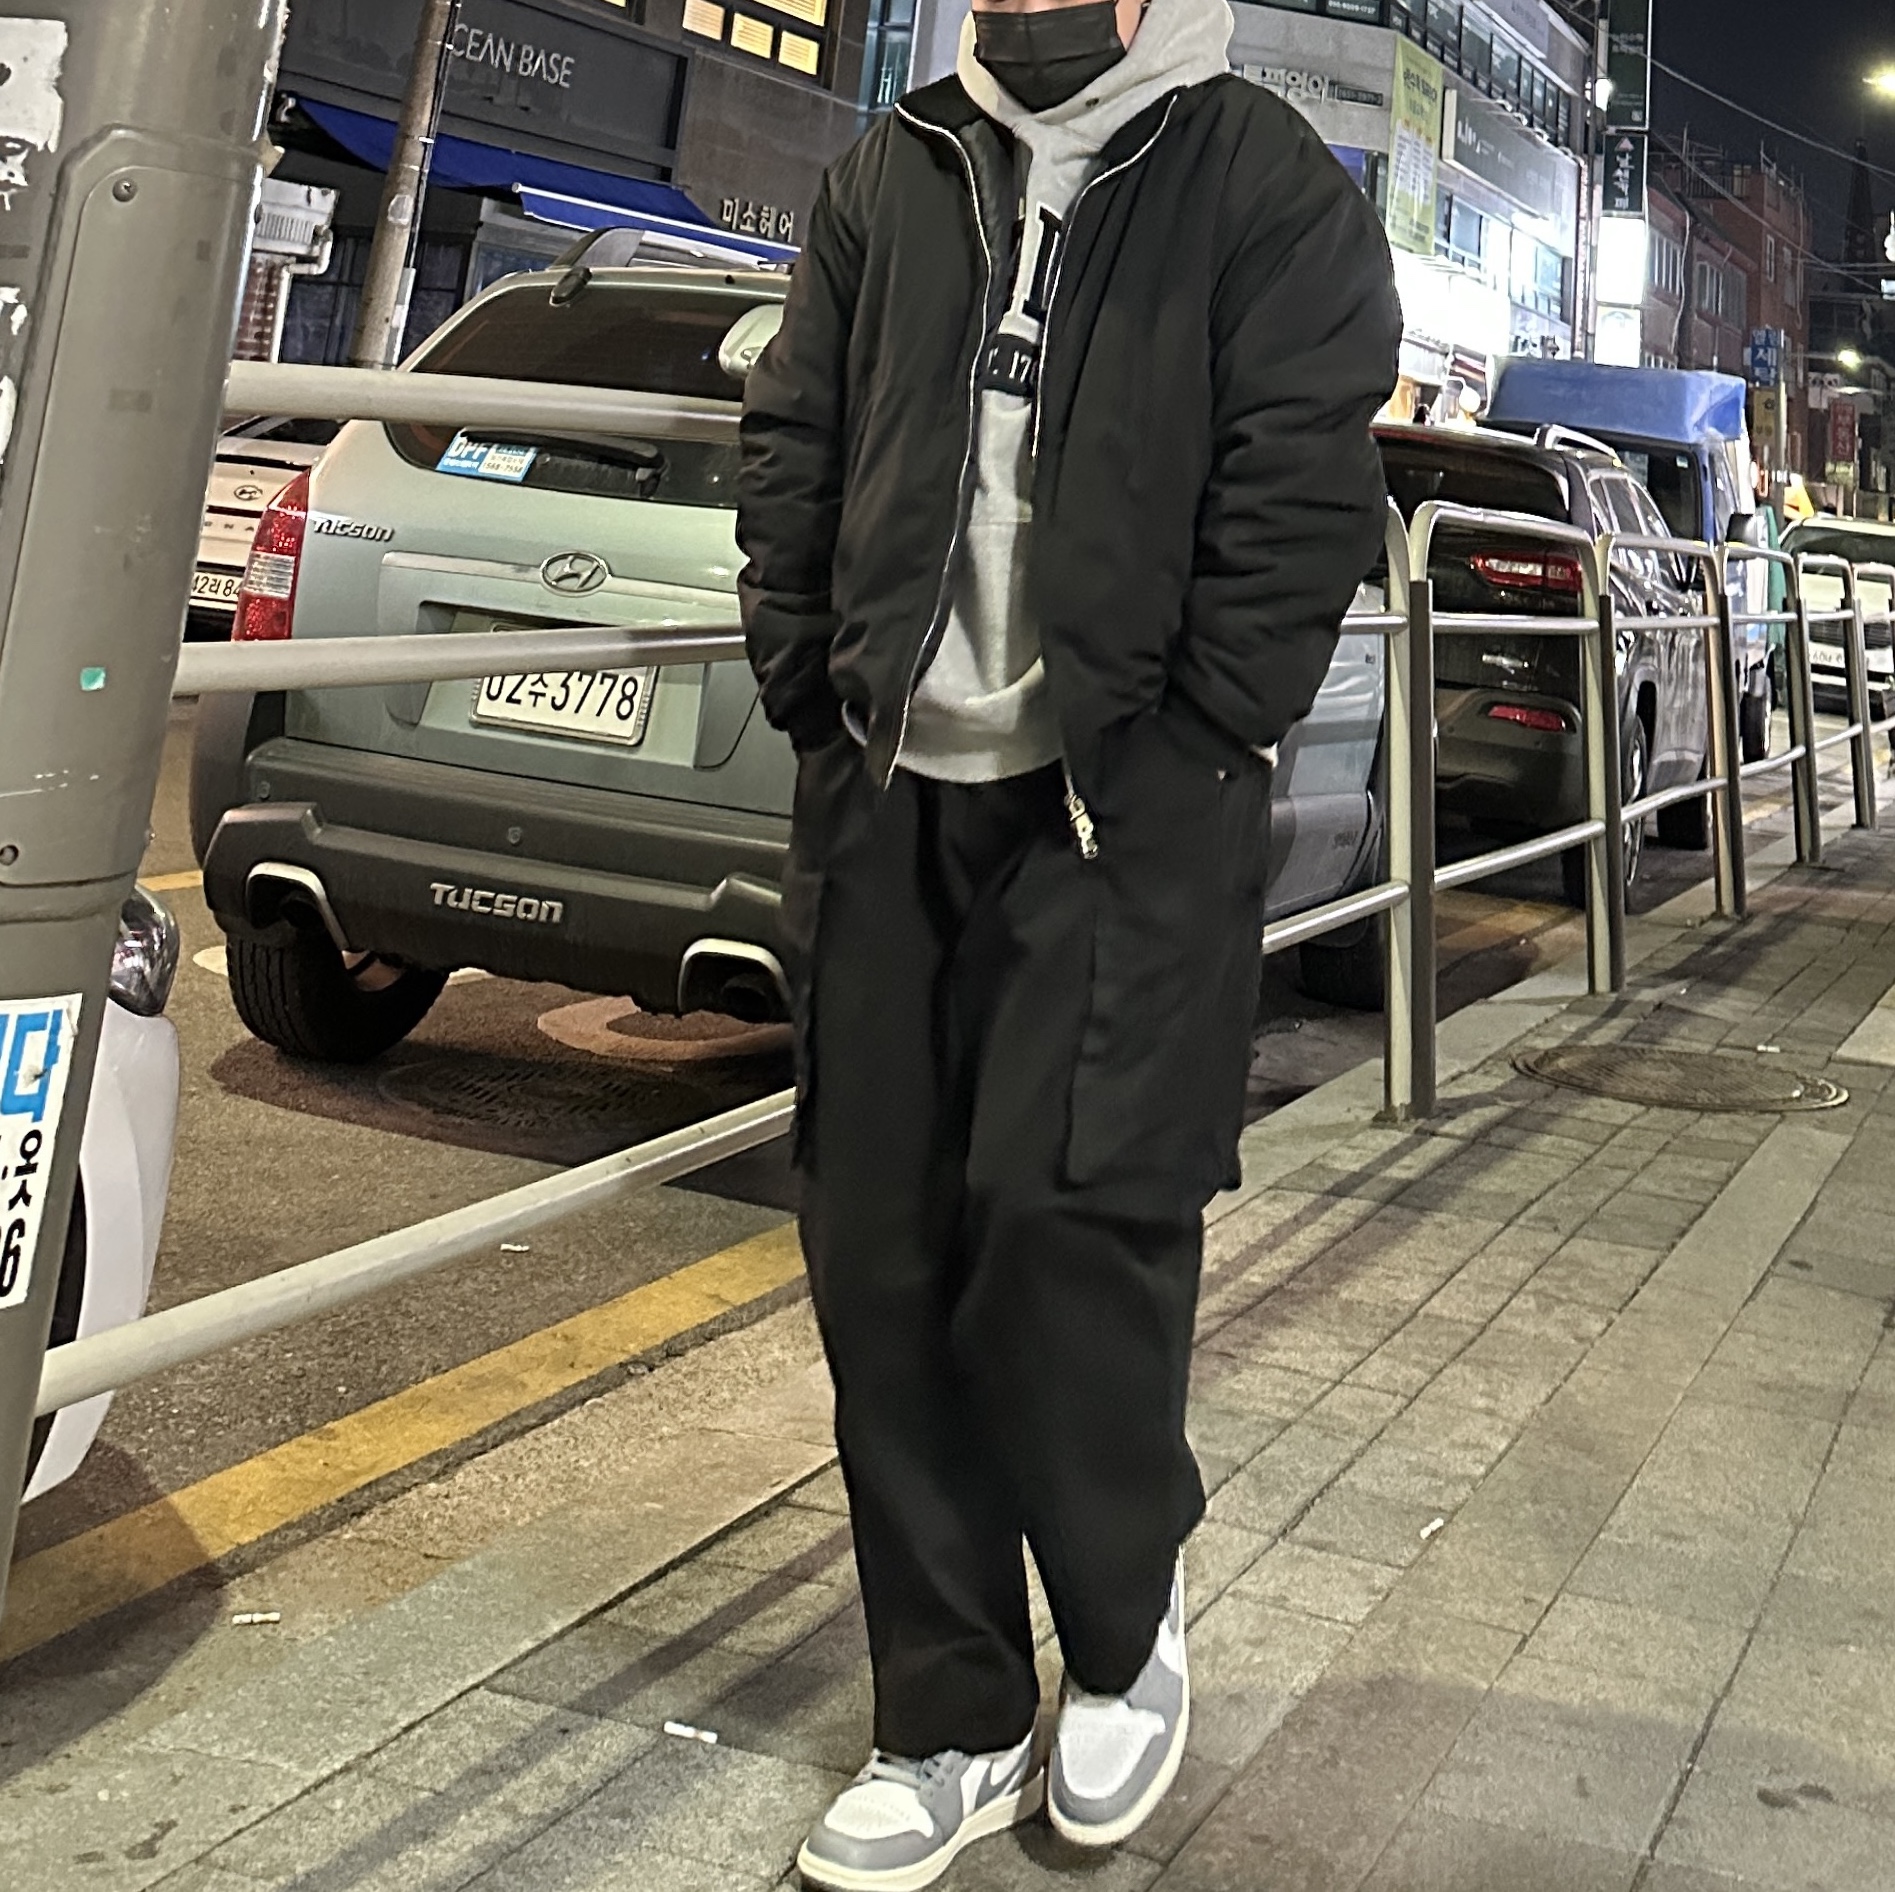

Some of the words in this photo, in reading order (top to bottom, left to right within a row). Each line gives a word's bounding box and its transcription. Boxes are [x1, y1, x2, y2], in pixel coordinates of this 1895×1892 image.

[518, 44, 575, 89] BASE
[722, 197, 794, 243] 미소헤어
[430, 882, 564, 924] TUCSON
